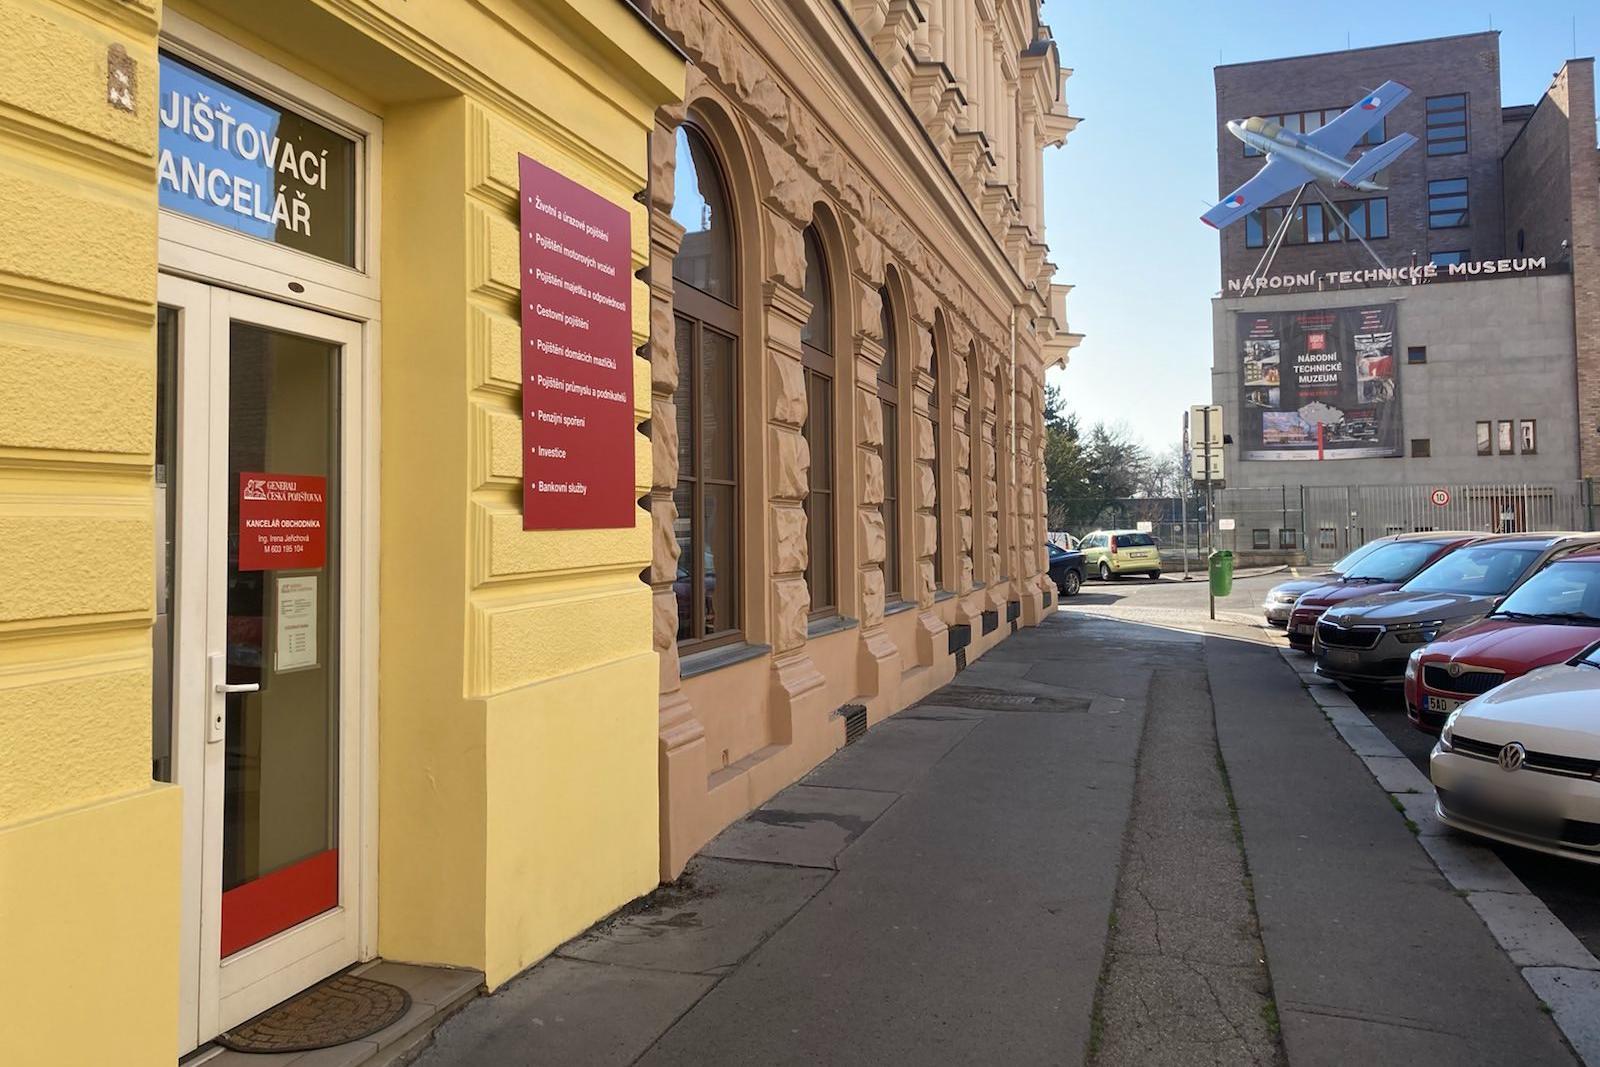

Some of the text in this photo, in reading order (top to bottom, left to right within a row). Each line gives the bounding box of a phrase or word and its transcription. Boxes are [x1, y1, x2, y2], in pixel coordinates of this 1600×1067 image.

[160, 90, 328, 191] JIŠŤOVACÍ
[158, 148, 311, 237] ANCELÁŘ
[535, 195, 609, 242] Životní a úrazové pojištění
[535, 233, 616, 277] Pojištění motorových vozidel
[1228, 256, 1547, 291] NÁRODNÍ TECHNICKÉ MUSEUM
[536, 268, 627, 312] Pojištění majetku a odpovědnosti
[536, 303, 590, 331] Cestovní pojištění
[537, 339, 617, 370] Pojištění domácích mazlíčků
[1297, 351, 1337, 363] NÁRODNÍ
[1293, 361, 1342, 373] TECHNICKÉ
[1298, 374, 1338, 384] MUZEUM
[537, 374, 627, 403] Pojištění průmyslu a podnikatelů
[538, 409, 586, 428] Penzijní spoření
[538, 445, 567, 459] Investice
[266, 480, 297, 491] GENERALI
[538, 480, 587, 495] Bankovní služby
[266, 489, 322, 503] ČESKÁ POJIŠŤOVNA
[1435, 493, 1445, 502] 10
[246, 518, 321, 528] KANCELÁŘ OBCHODNÍKA
[269, 534, 284, 542] Irena
[264, 545, 270, 553] M
[271, 544, 282, 553] 603
[1430, 697, 1447, 711] 5AD
